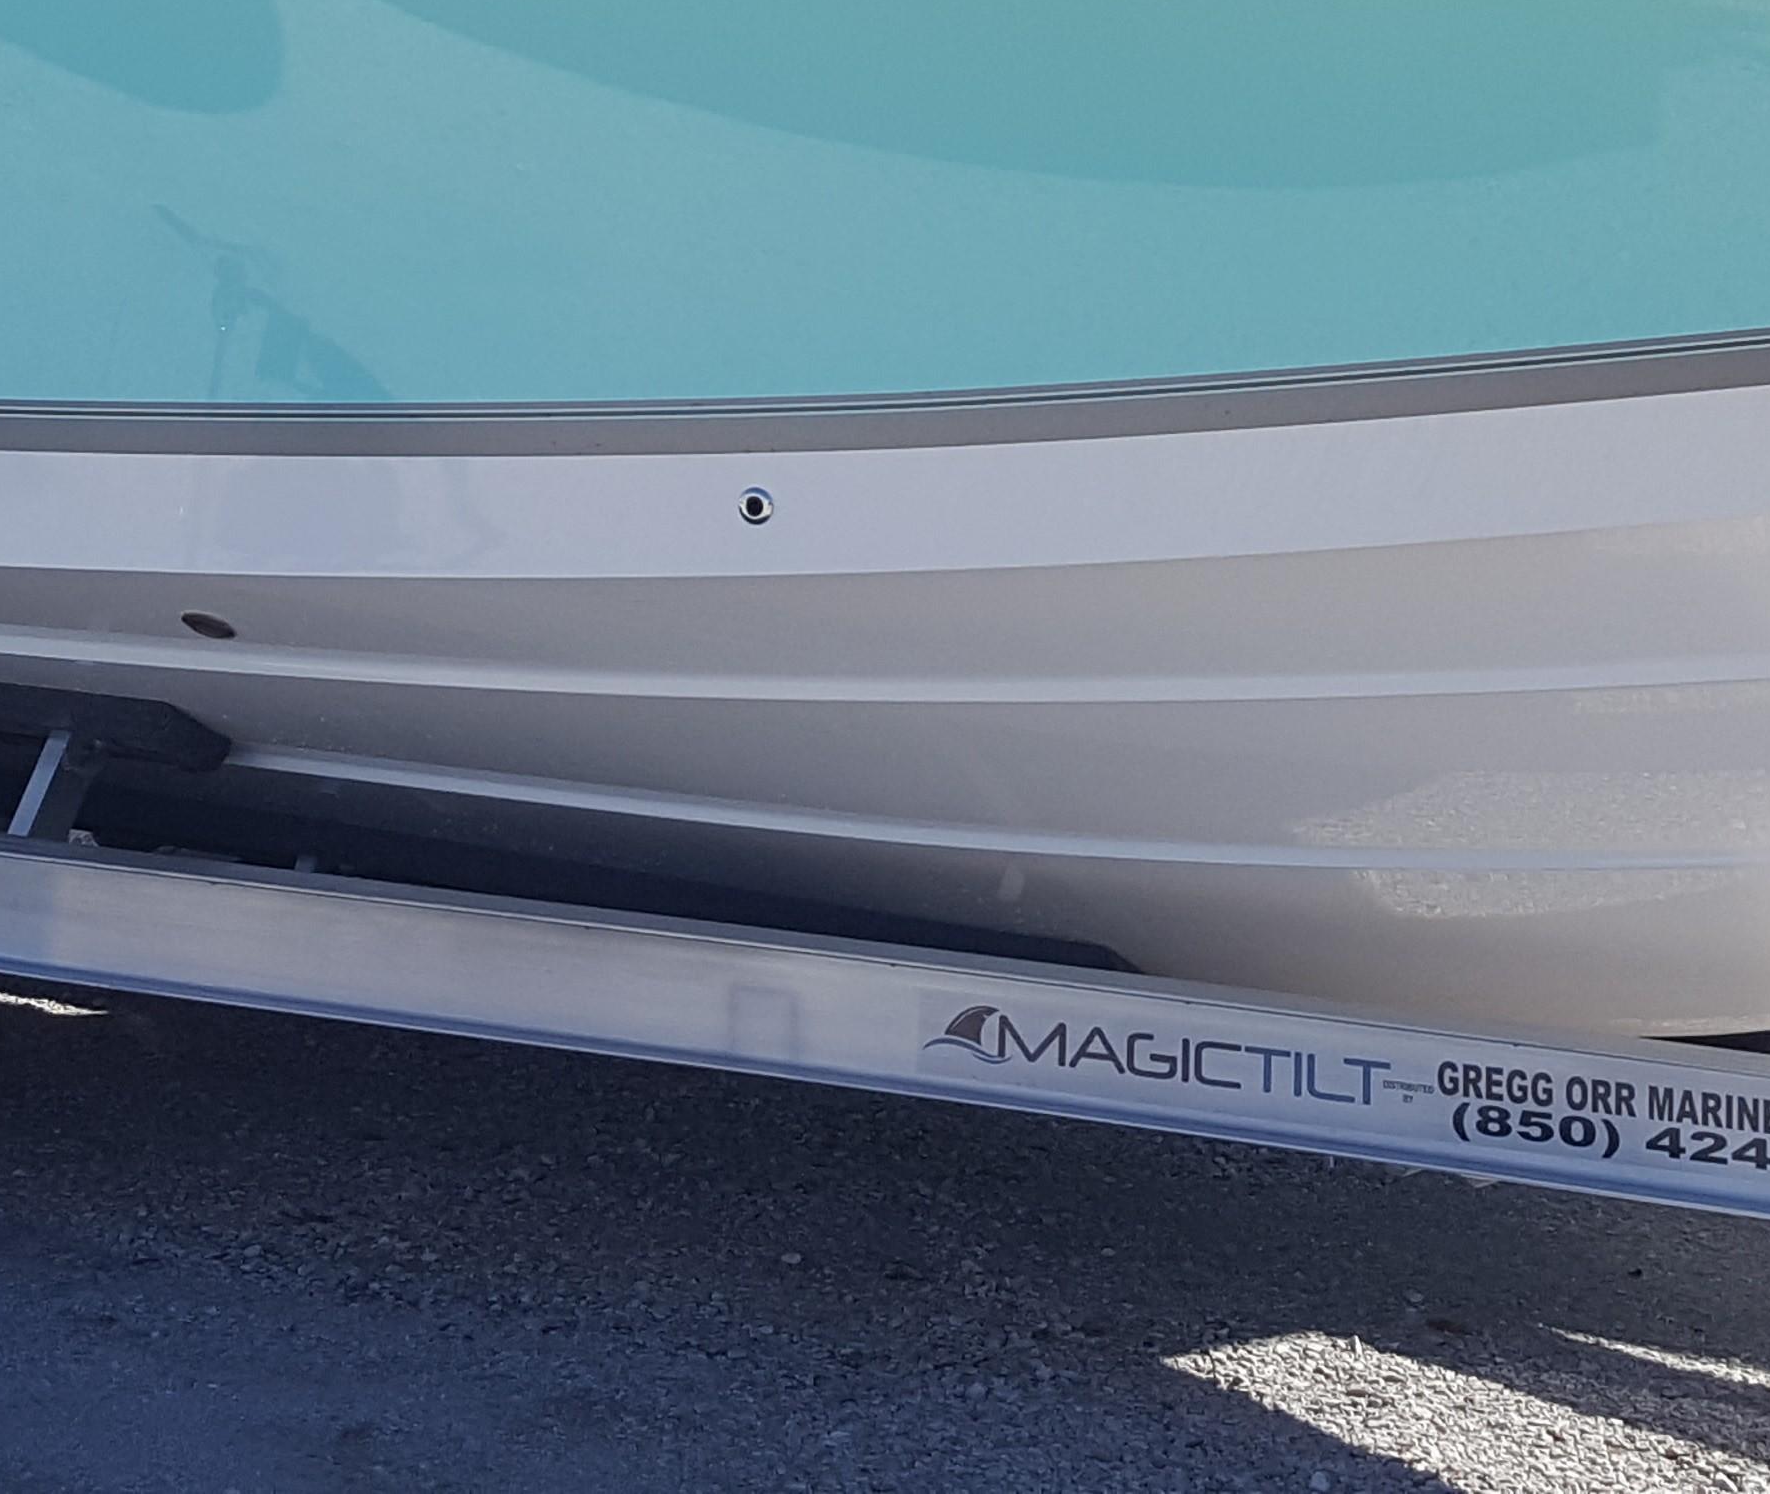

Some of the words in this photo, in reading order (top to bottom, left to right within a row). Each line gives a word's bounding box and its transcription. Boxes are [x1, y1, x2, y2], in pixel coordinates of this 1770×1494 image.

[998, 1013, 1392, 1106] MAGICTILT
[1437, 1061, 1554, 1106] GREGG
[1565, 1076, 1637, 1118] ORR
[1452, 1102, 1621, 1159] (850)
